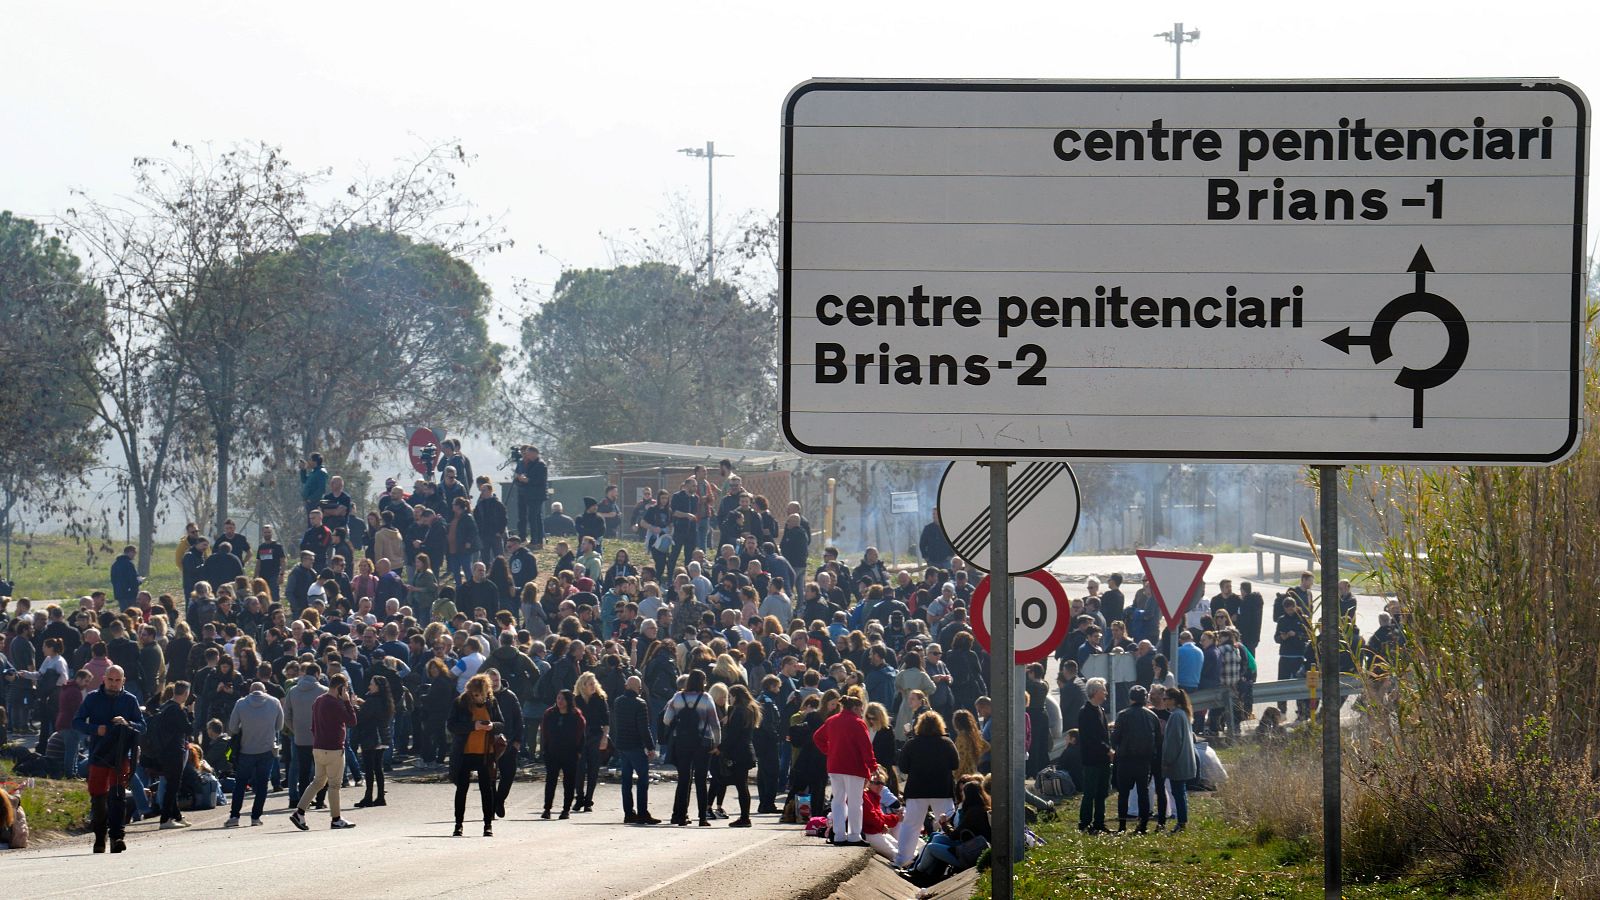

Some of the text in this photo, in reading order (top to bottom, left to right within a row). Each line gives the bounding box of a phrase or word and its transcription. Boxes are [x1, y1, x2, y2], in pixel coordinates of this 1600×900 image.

[1054, 116, 1553, 171] centre penitenciari
[1208, 178, 1388, 220] Brians
[816, 285, 1303, 338] centre penitenciari
[815, 343, 1047, 385] Brians-2
[1015, 597, 1048, 629] 0
